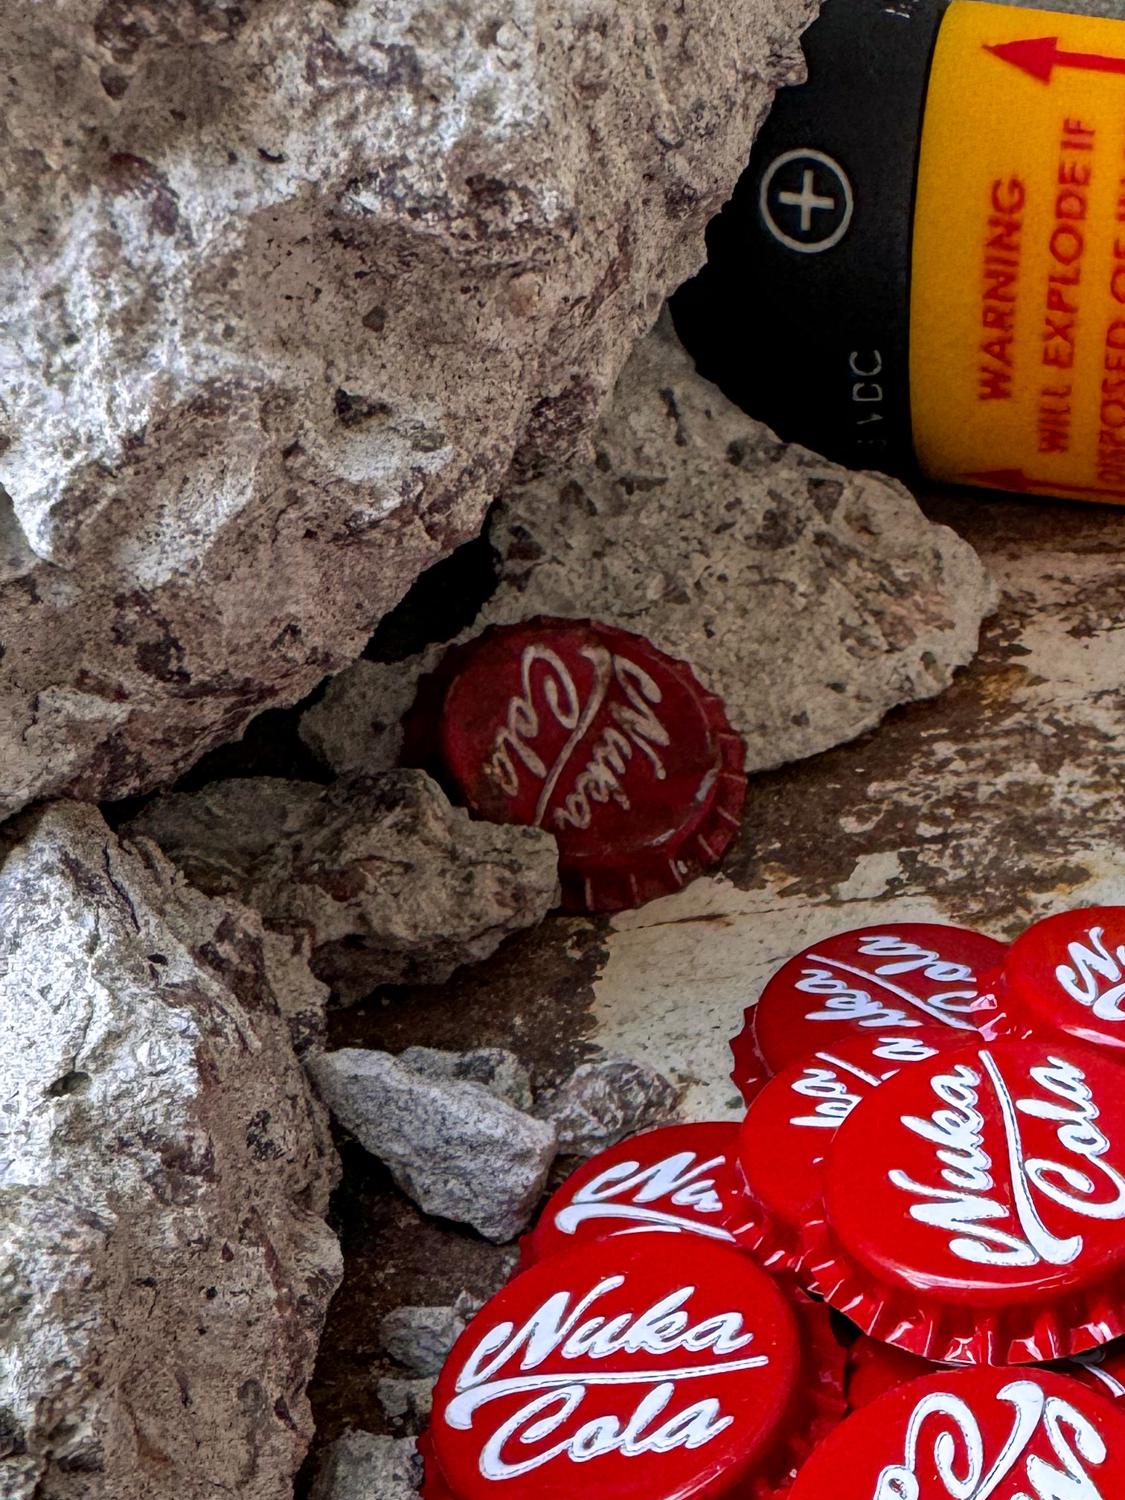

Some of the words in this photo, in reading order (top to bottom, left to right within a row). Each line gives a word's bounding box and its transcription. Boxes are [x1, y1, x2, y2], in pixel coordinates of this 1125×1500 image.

[1060, 117, 1096, 151] IF
[977, 173, 1026, 401] WARNING
[1041, 161, 1092, 369] EXPLODE
[1037, 384, 1072, 454] WILL
[481, 644, 580, 797] Cola
[553, 654, 671, 830] Nuka
[793, 969, 923, 1028] uka
[888, 1065, 1041, 1267] Nuka
[455, 1275, 754, 1392] Nuka
[478, 1381, 735, 1481] Cola
